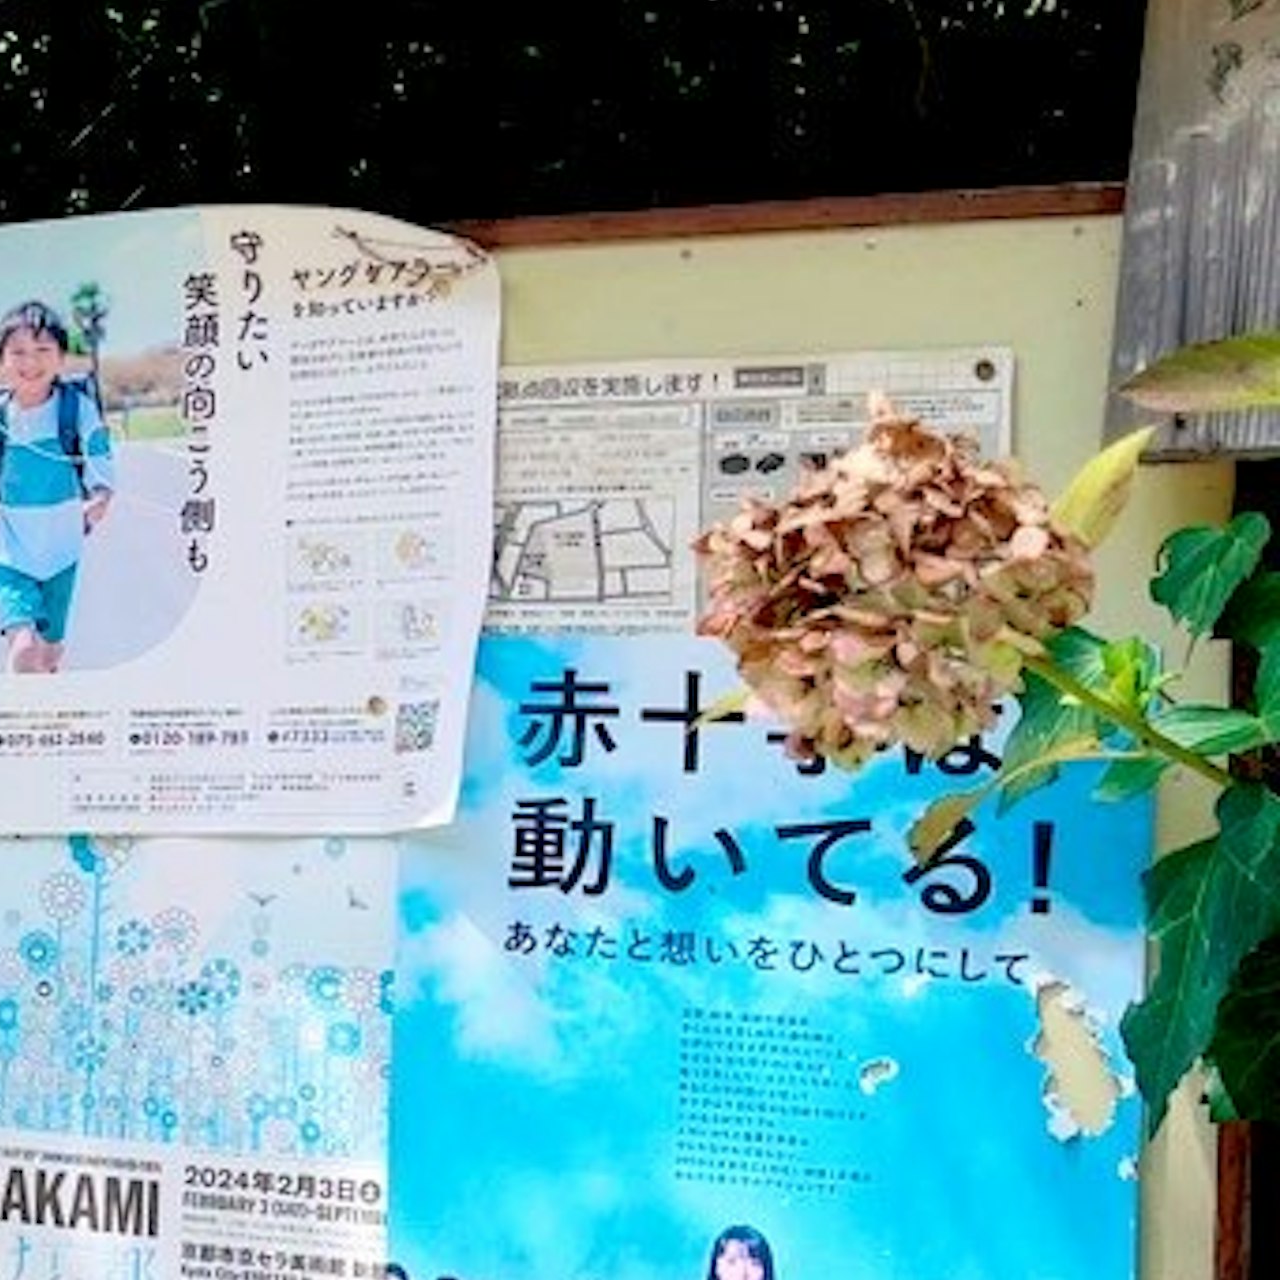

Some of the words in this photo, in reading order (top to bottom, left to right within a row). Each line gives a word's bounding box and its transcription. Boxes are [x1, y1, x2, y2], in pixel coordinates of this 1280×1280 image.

[230, 230, 269, 371] 守りたい
[180, 272, 220, 574] 笑顔の向こう側も
[520, 669, 1004, 776] 赤十
[507, 797, 1055, 916] 動いてる！
[503, 921, 1032, 987] あなたと想いをひとつにして
